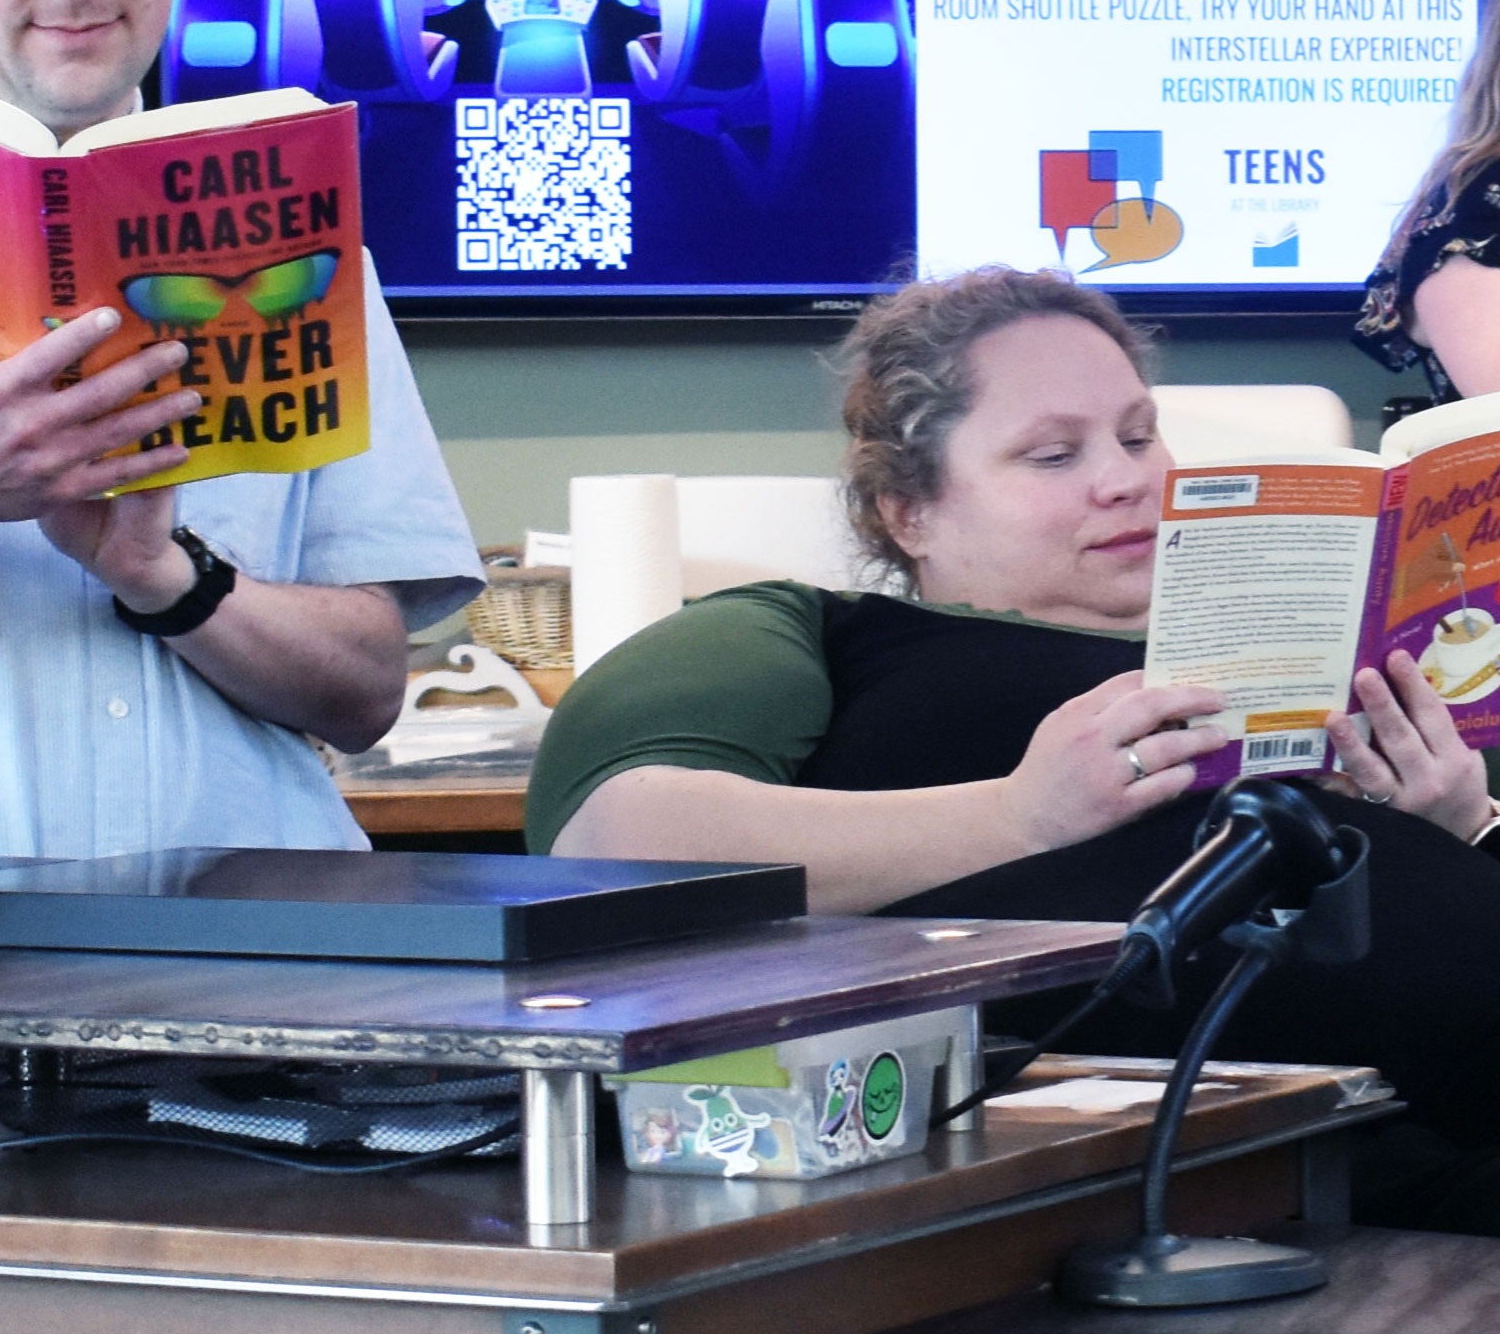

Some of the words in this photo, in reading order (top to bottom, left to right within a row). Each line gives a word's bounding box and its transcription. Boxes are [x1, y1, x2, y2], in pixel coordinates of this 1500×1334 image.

[1171, 36, 1322, 62] INTERSTELLAR
[1162, 76, 1316, 103] REGISTRATION
[1323, 77, 1344, 103] IS
[163, 146, 293, 204] CARL
[1223, 148, 1326, 185] TEENS
[41, 168, 70, 214] CARL
[117, 187, 339, 258] HIAASEN
[46, 224, 77, 307] HIAASEN
